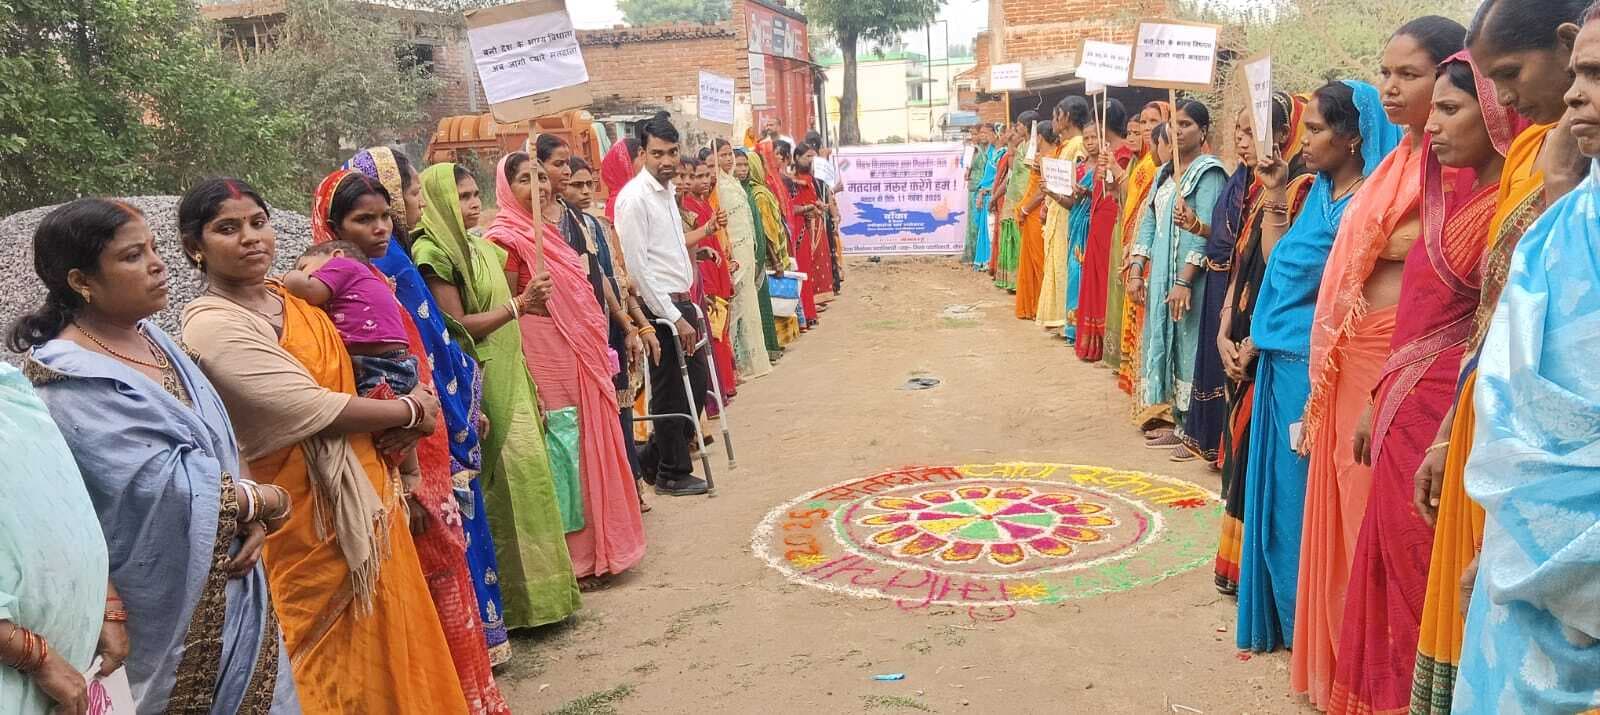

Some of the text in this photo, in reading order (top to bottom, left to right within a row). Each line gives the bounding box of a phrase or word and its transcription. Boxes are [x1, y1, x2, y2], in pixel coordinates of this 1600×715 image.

[500, 43, 513, 53] देश
[517, 40, 524, 48] के
[847, 182, 881, 193] मतदान
[909, 178, 932, 192] करेंगे
[934, 180, 951, 191] हम
